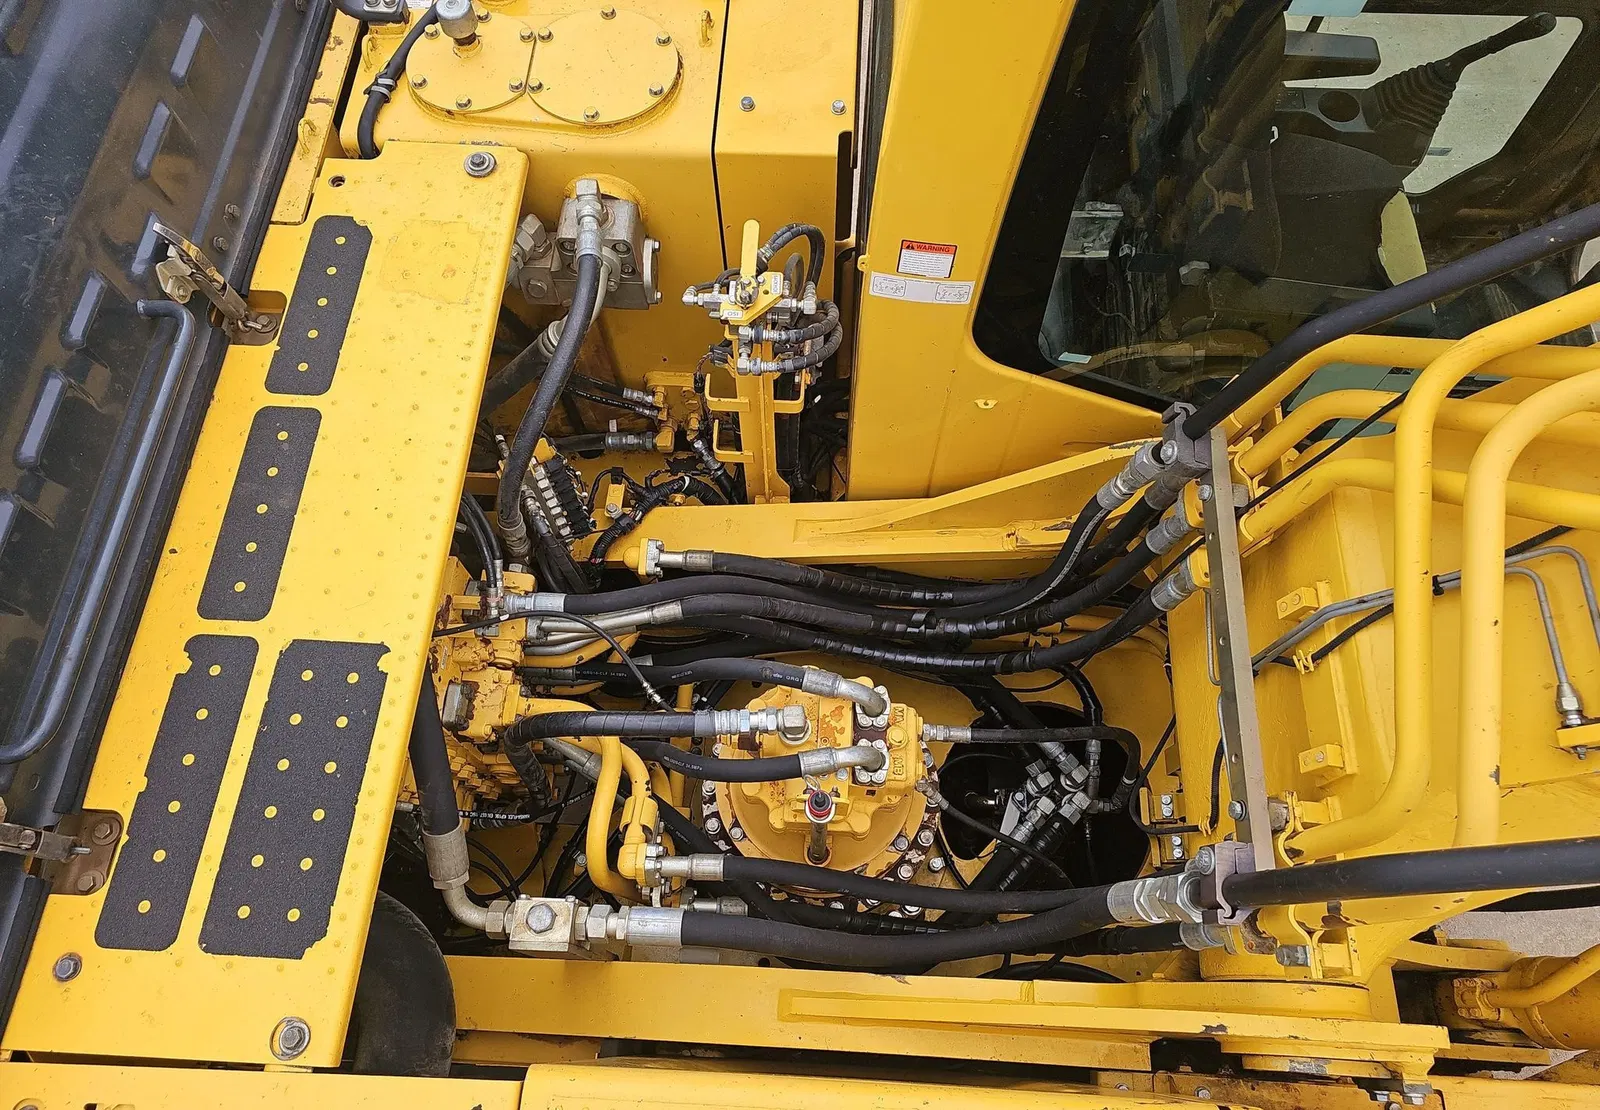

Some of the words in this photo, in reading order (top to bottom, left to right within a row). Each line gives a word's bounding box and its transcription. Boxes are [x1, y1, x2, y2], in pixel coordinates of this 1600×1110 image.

[916, 244, 951, 253] WARNING
[893, 706, 904, 724] MA
[893, 757, 904, 776] MB
